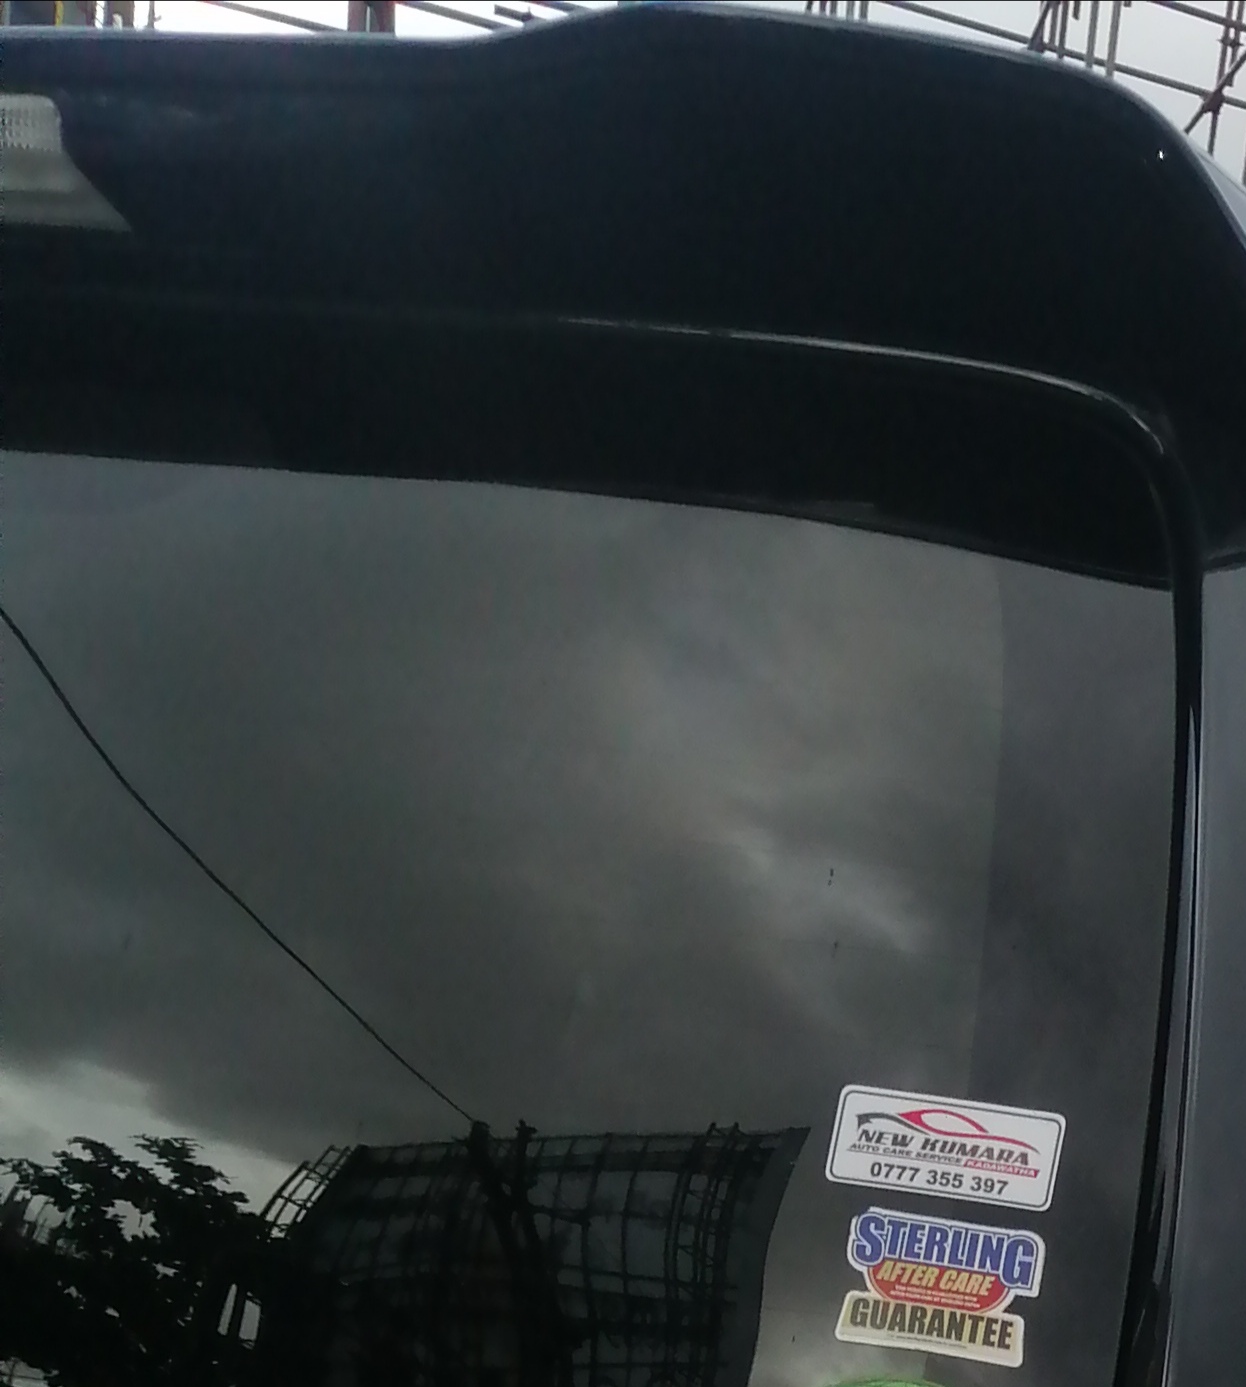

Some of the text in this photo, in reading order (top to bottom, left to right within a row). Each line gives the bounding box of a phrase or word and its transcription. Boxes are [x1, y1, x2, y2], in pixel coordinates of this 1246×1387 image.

[850, 1143, 880, 1152] AUTO
[883, 1147, 912, 1156] CARE
[915, 1151, 961, 1164] SERVICE
[857, 1129, 1029, 1166] NEW KUMARA
[870, 1162, 1009, 1195] 0777 355 397
[853, 1213, 1034, 1289] STERLING
[876, 1260, 939, 1288] AFTER
[939, 1269, 996, 1297] CARE
[850, 1298, 1014, 1350] GUARANTEE
